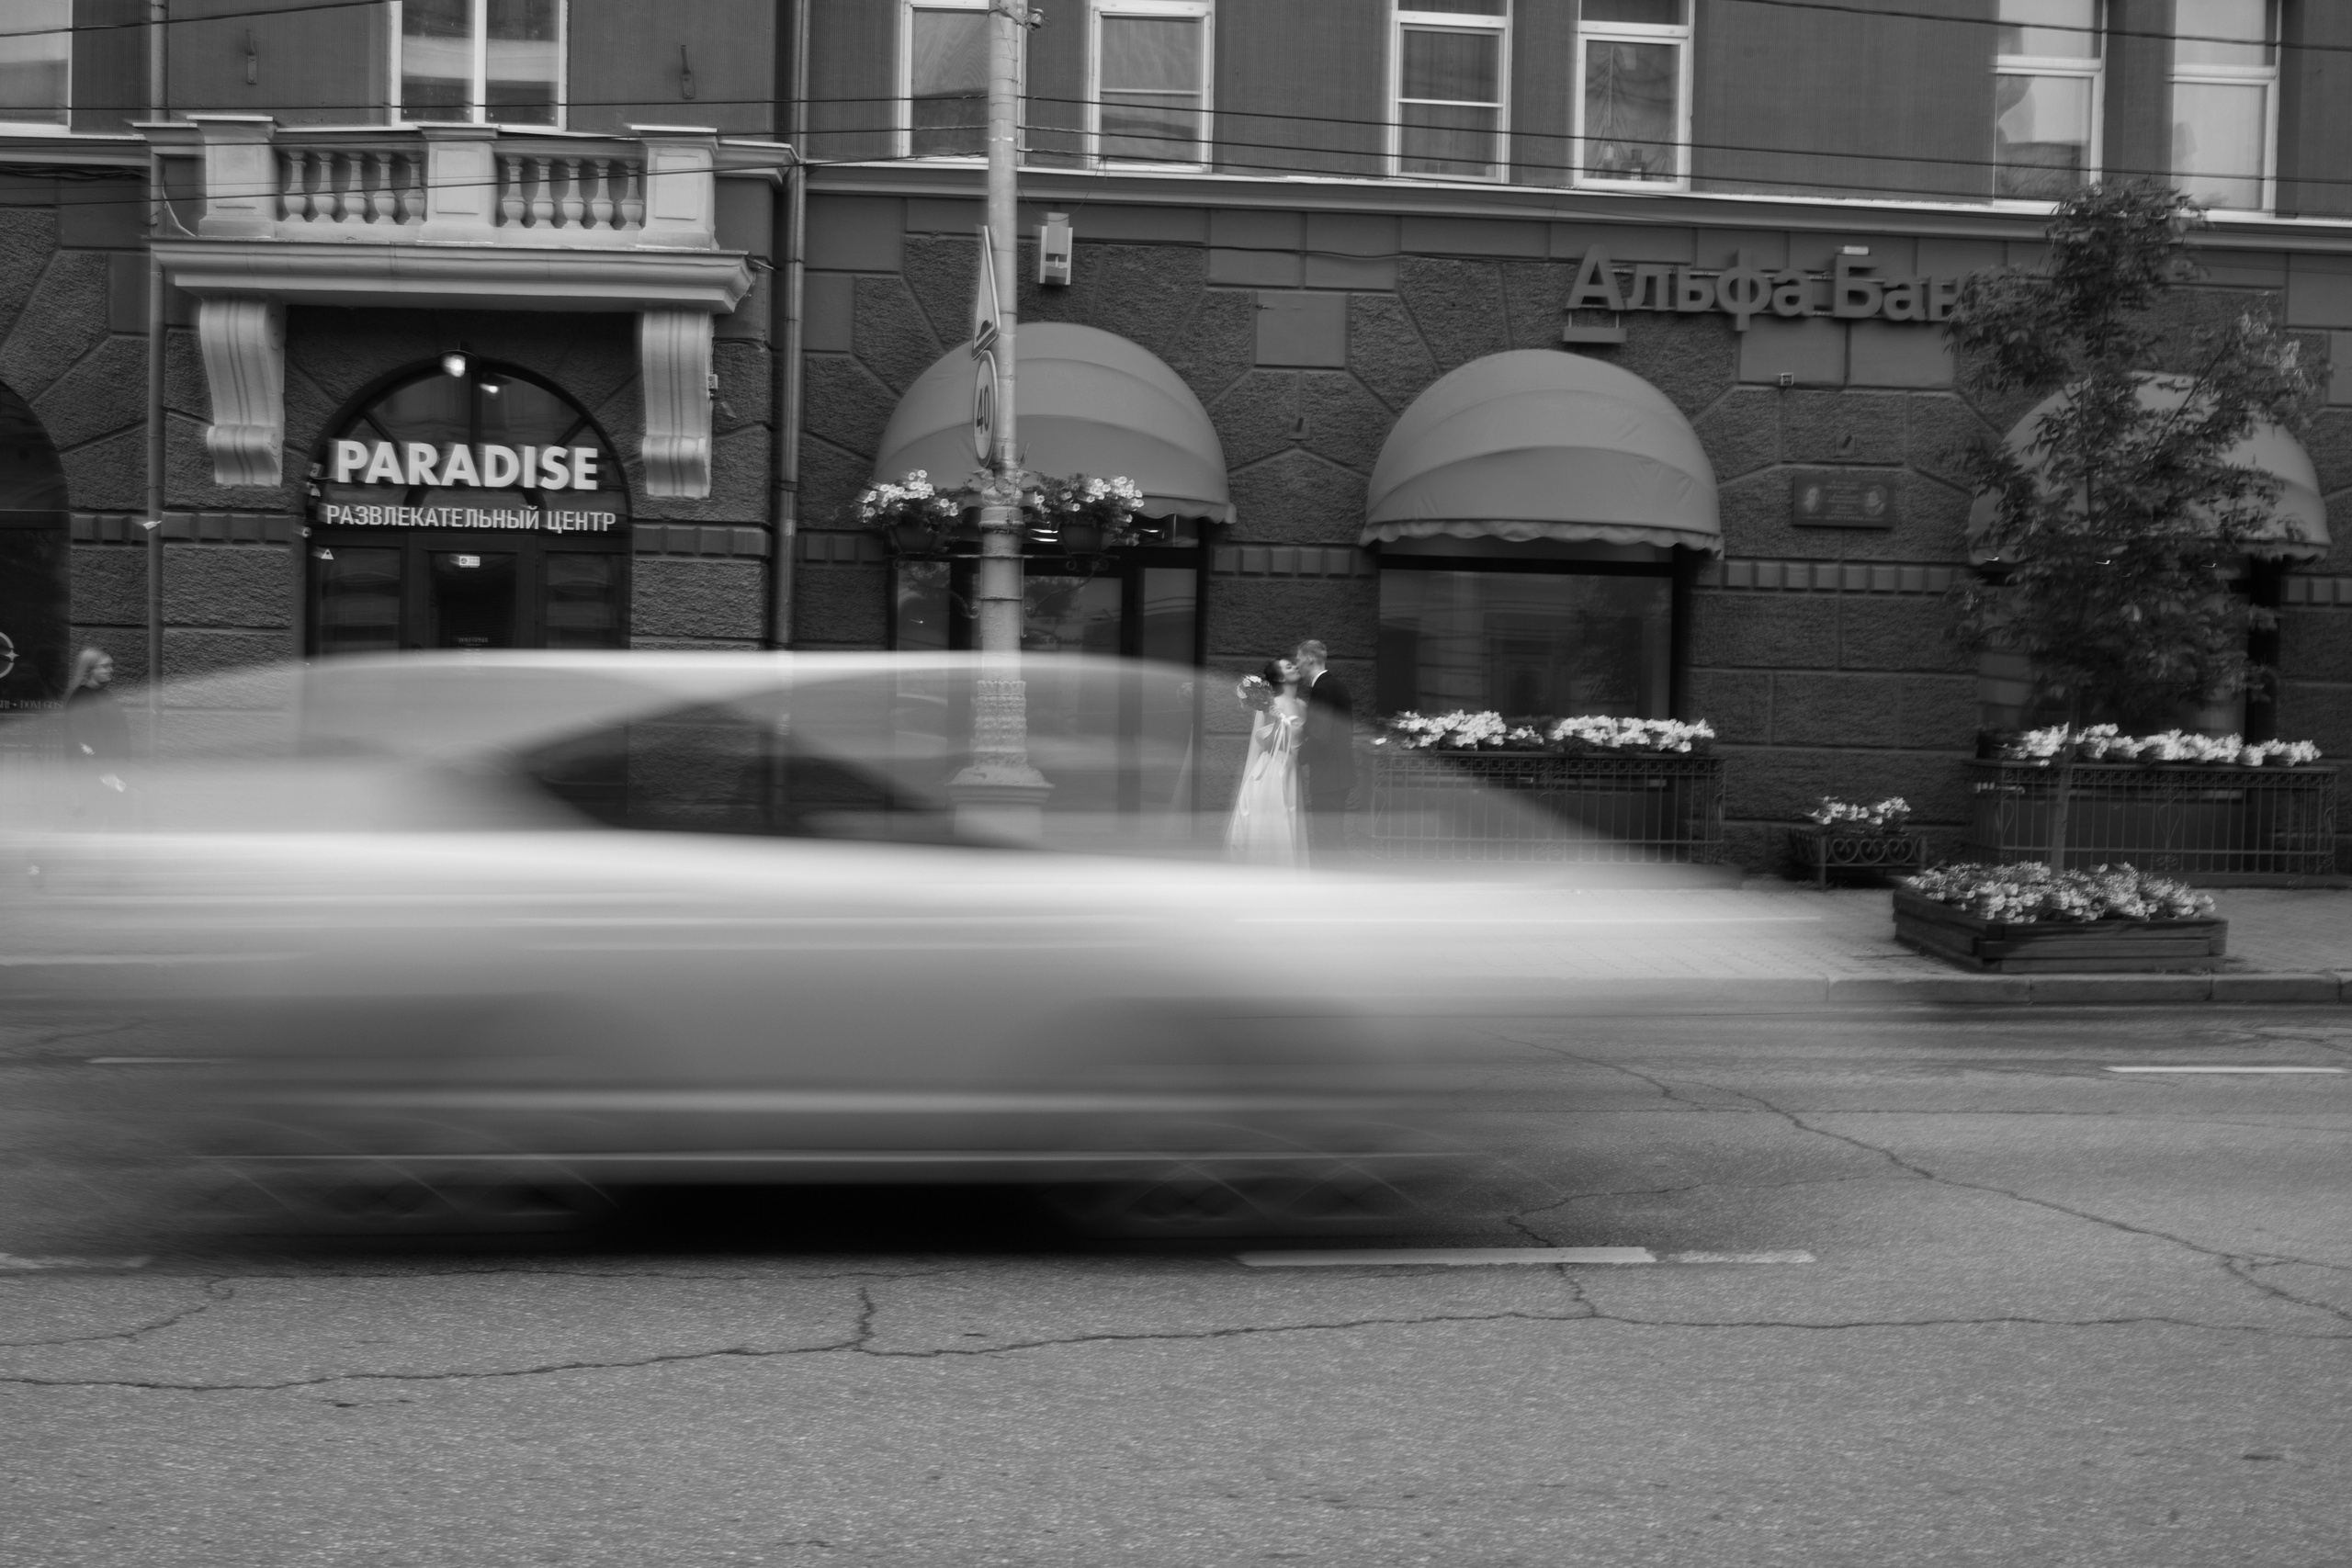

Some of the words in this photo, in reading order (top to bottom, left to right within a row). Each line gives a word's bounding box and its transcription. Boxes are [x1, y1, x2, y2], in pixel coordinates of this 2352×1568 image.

[1565, 243, 1815, 332] Альфа
[1835, 254, 1966, 321] Бан
[977, 384, 989, 435] 40
[336, 439, 599, 491] PARADISE
[326, 504, 540, 530] РАЗВЛЕКАТЕЛЬНЫЙ
[547, 511, 616, 534] ЦЕНТР
